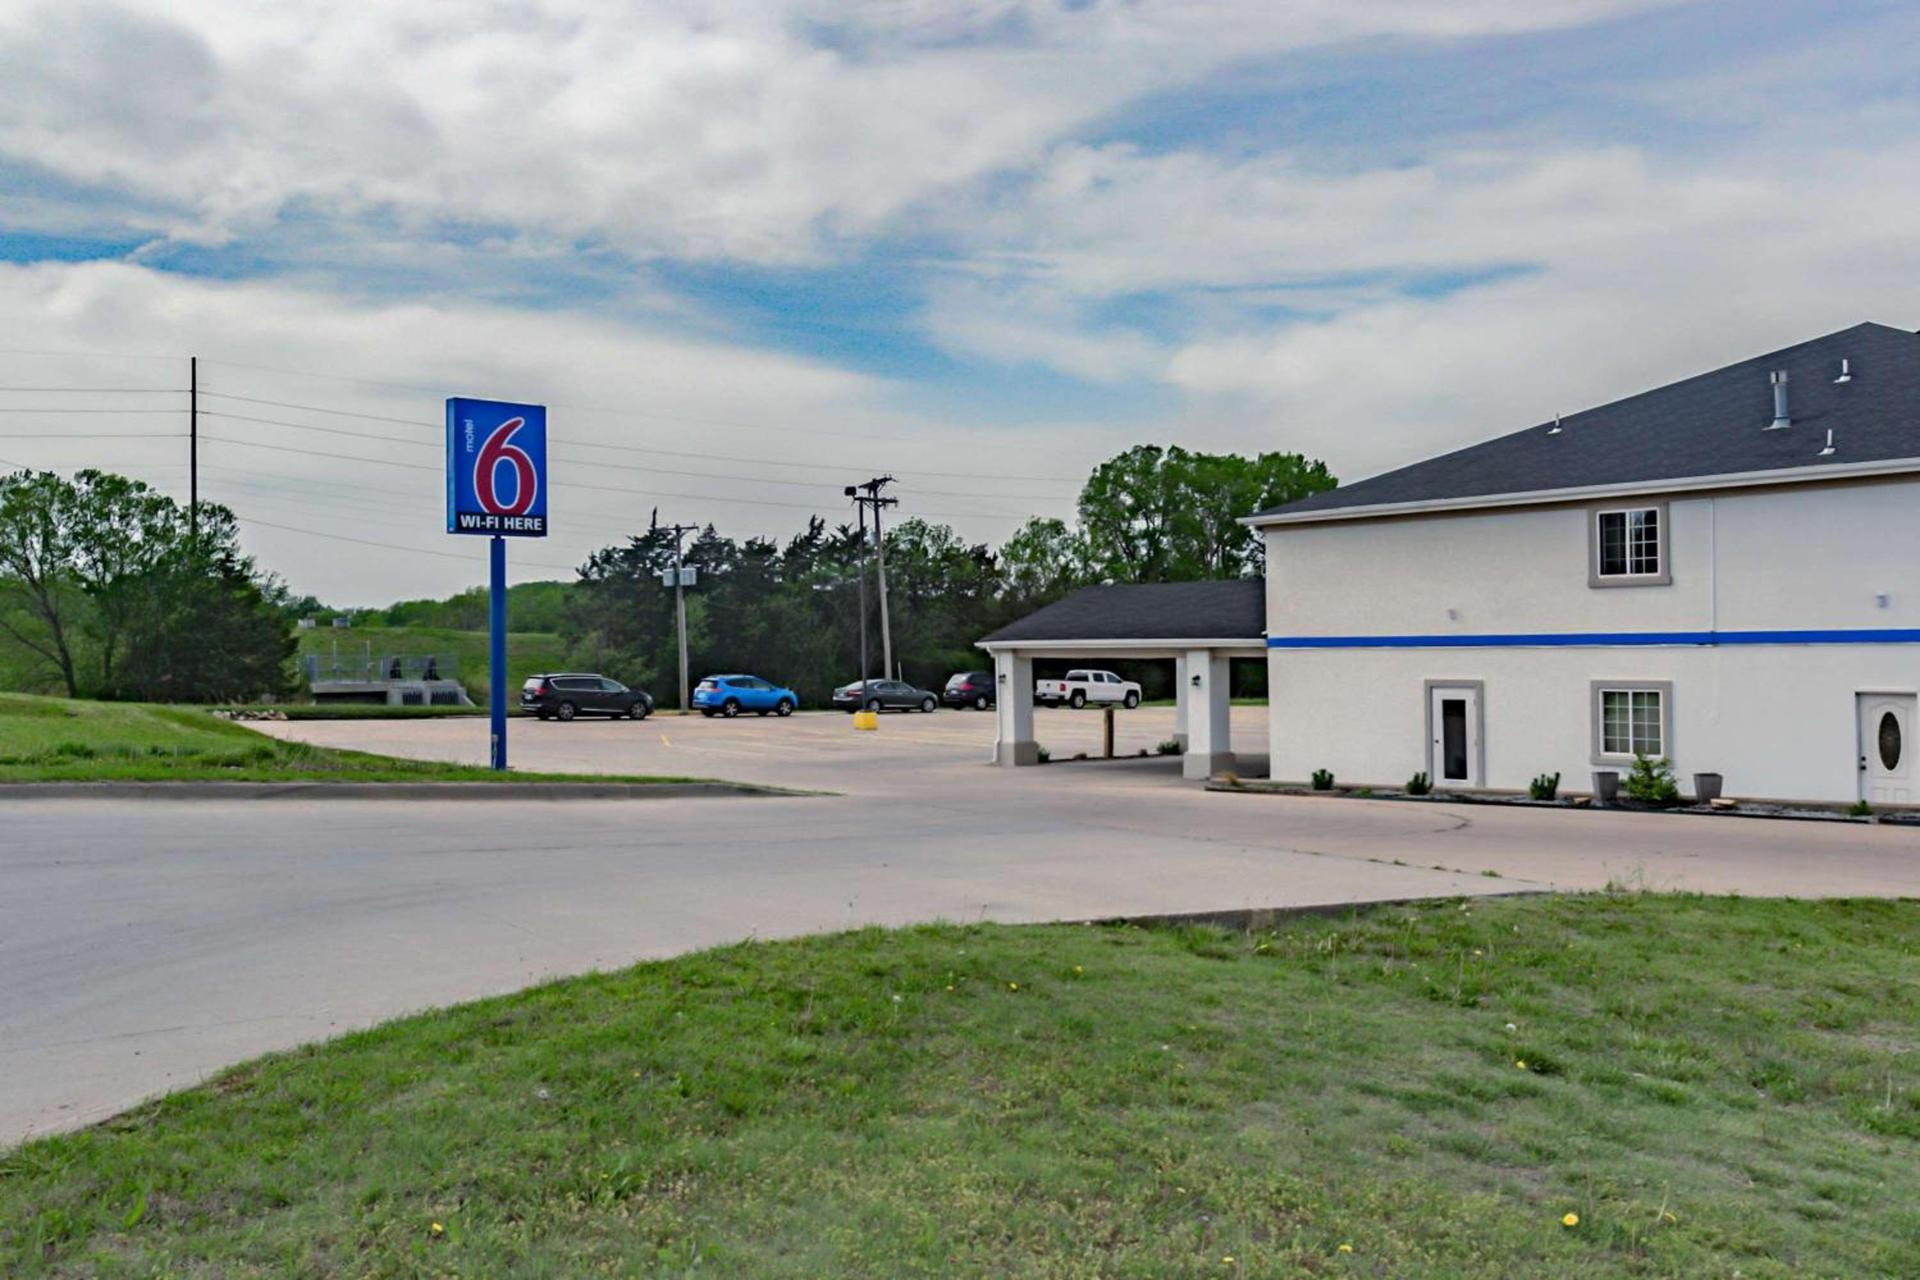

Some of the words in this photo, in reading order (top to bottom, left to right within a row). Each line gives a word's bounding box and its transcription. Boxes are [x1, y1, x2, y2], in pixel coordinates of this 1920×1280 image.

[464, 419, 474, 453] motel
[473, 416, 538, 515] 6
[460, 514, 500, 529] WI-FI
[504, 516, 543, 531] HERE
